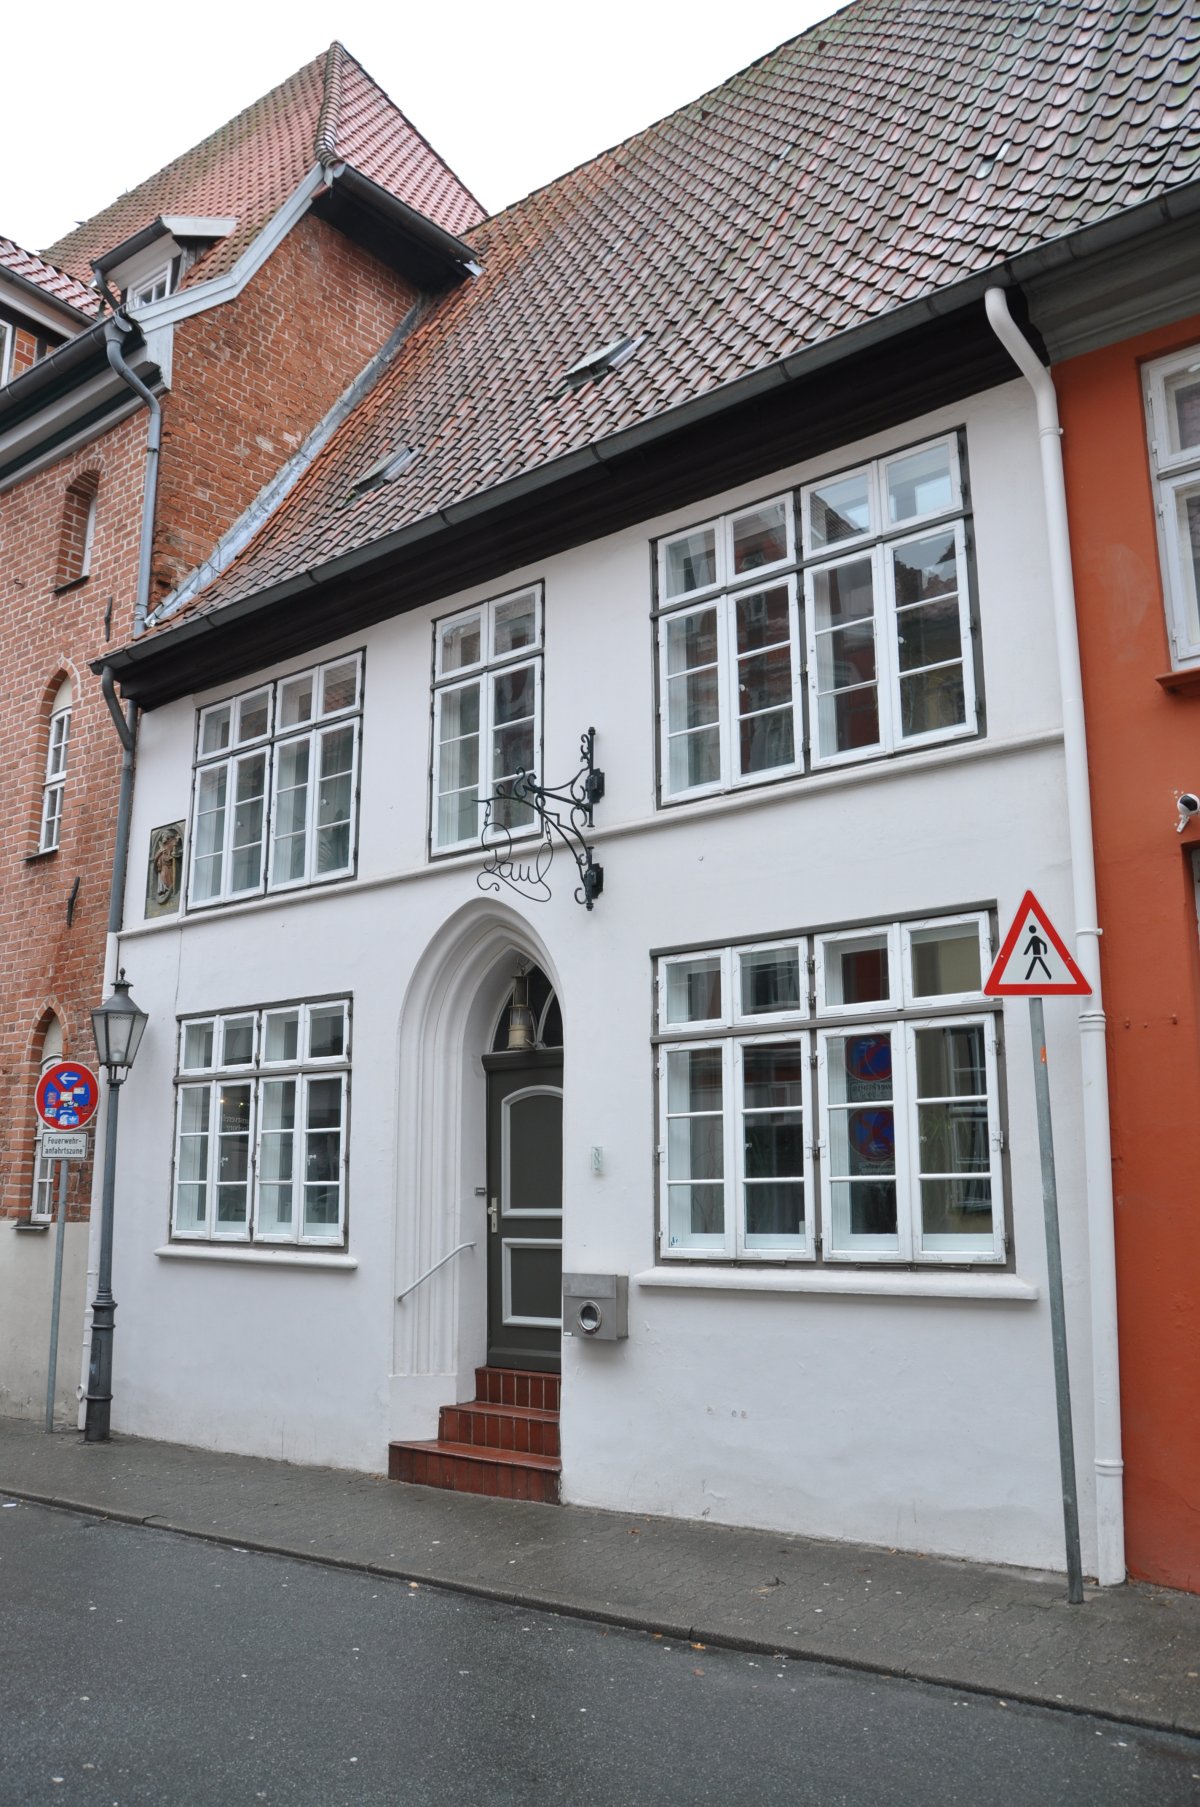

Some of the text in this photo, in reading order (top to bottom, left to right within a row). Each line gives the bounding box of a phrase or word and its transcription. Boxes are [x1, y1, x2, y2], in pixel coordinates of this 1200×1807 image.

[477, 822, 553, 902] Paul
[47, 1136, 82, 1145] Feuerwehr-
[45, 1147, 83, 1155] anfahrtszone
